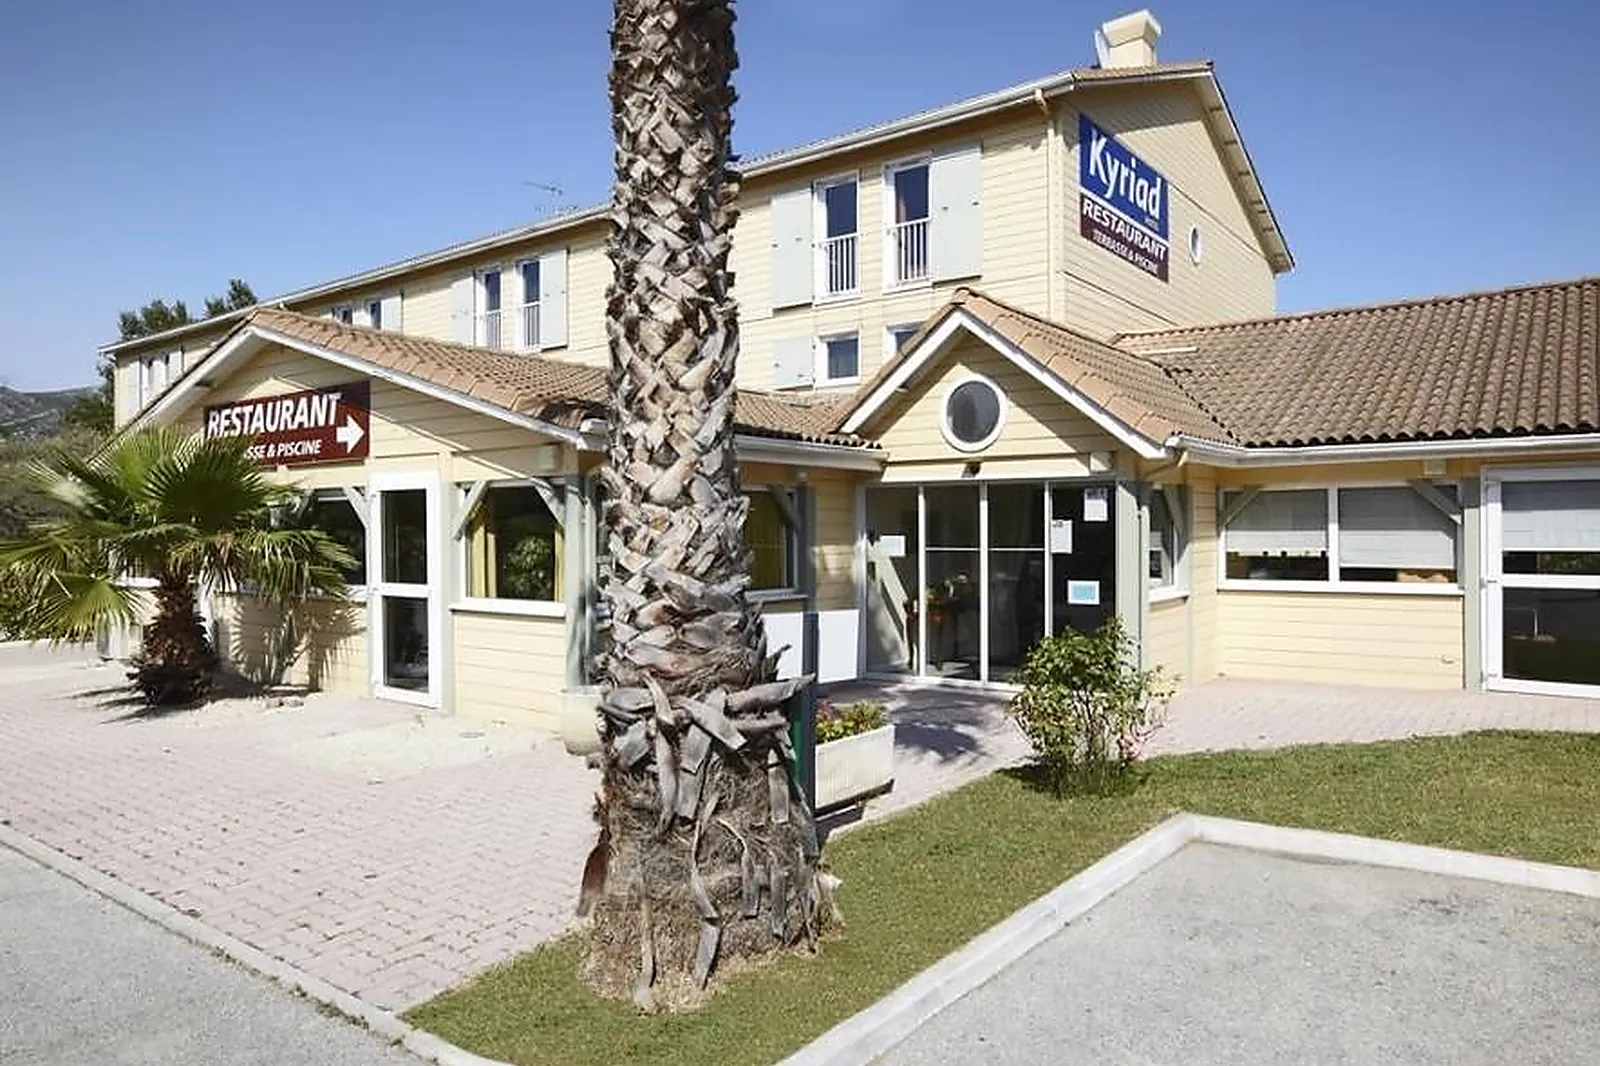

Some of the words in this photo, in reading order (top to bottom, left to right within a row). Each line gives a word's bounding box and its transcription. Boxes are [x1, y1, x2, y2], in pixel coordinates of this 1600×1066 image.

[1089, 128, 1161, 219] Kyriad
[1083, 198, 1166, 260] RESTAURANT
[207, 392, 342, 439] RESTAURANT
[266, 443, 276, 458] &
[277, 439, 323, 457] PISCINE
